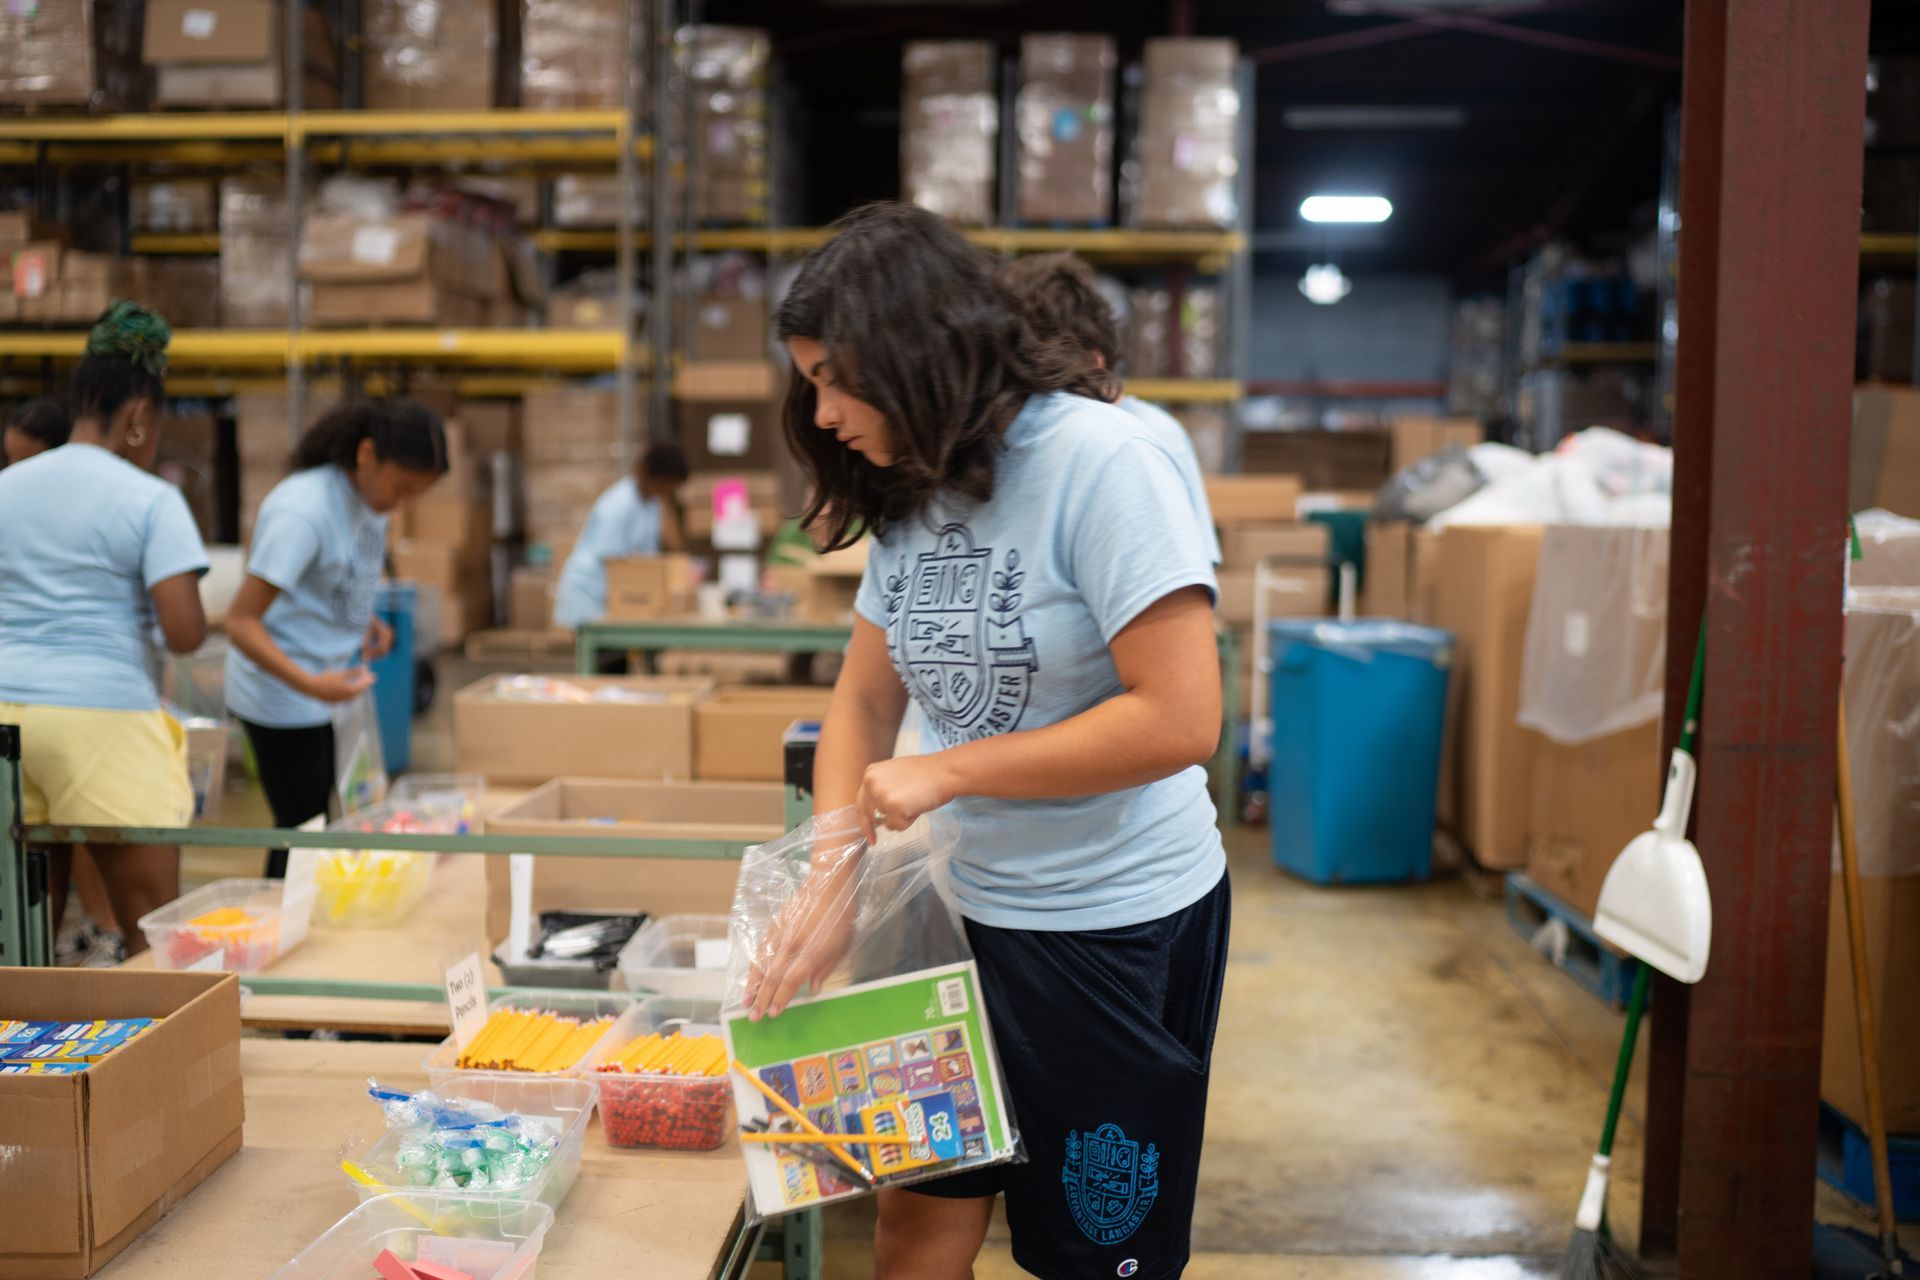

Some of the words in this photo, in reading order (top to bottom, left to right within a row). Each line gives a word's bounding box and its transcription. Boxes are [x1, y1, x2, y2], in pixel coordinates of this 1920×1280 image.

[449, 979, 463, 995] Two
[454, 996, 477, 1020] Pencils
[929, 1111, 952, 1142] 24
[1101, 1199, 1151, 1241] LANCASTER
